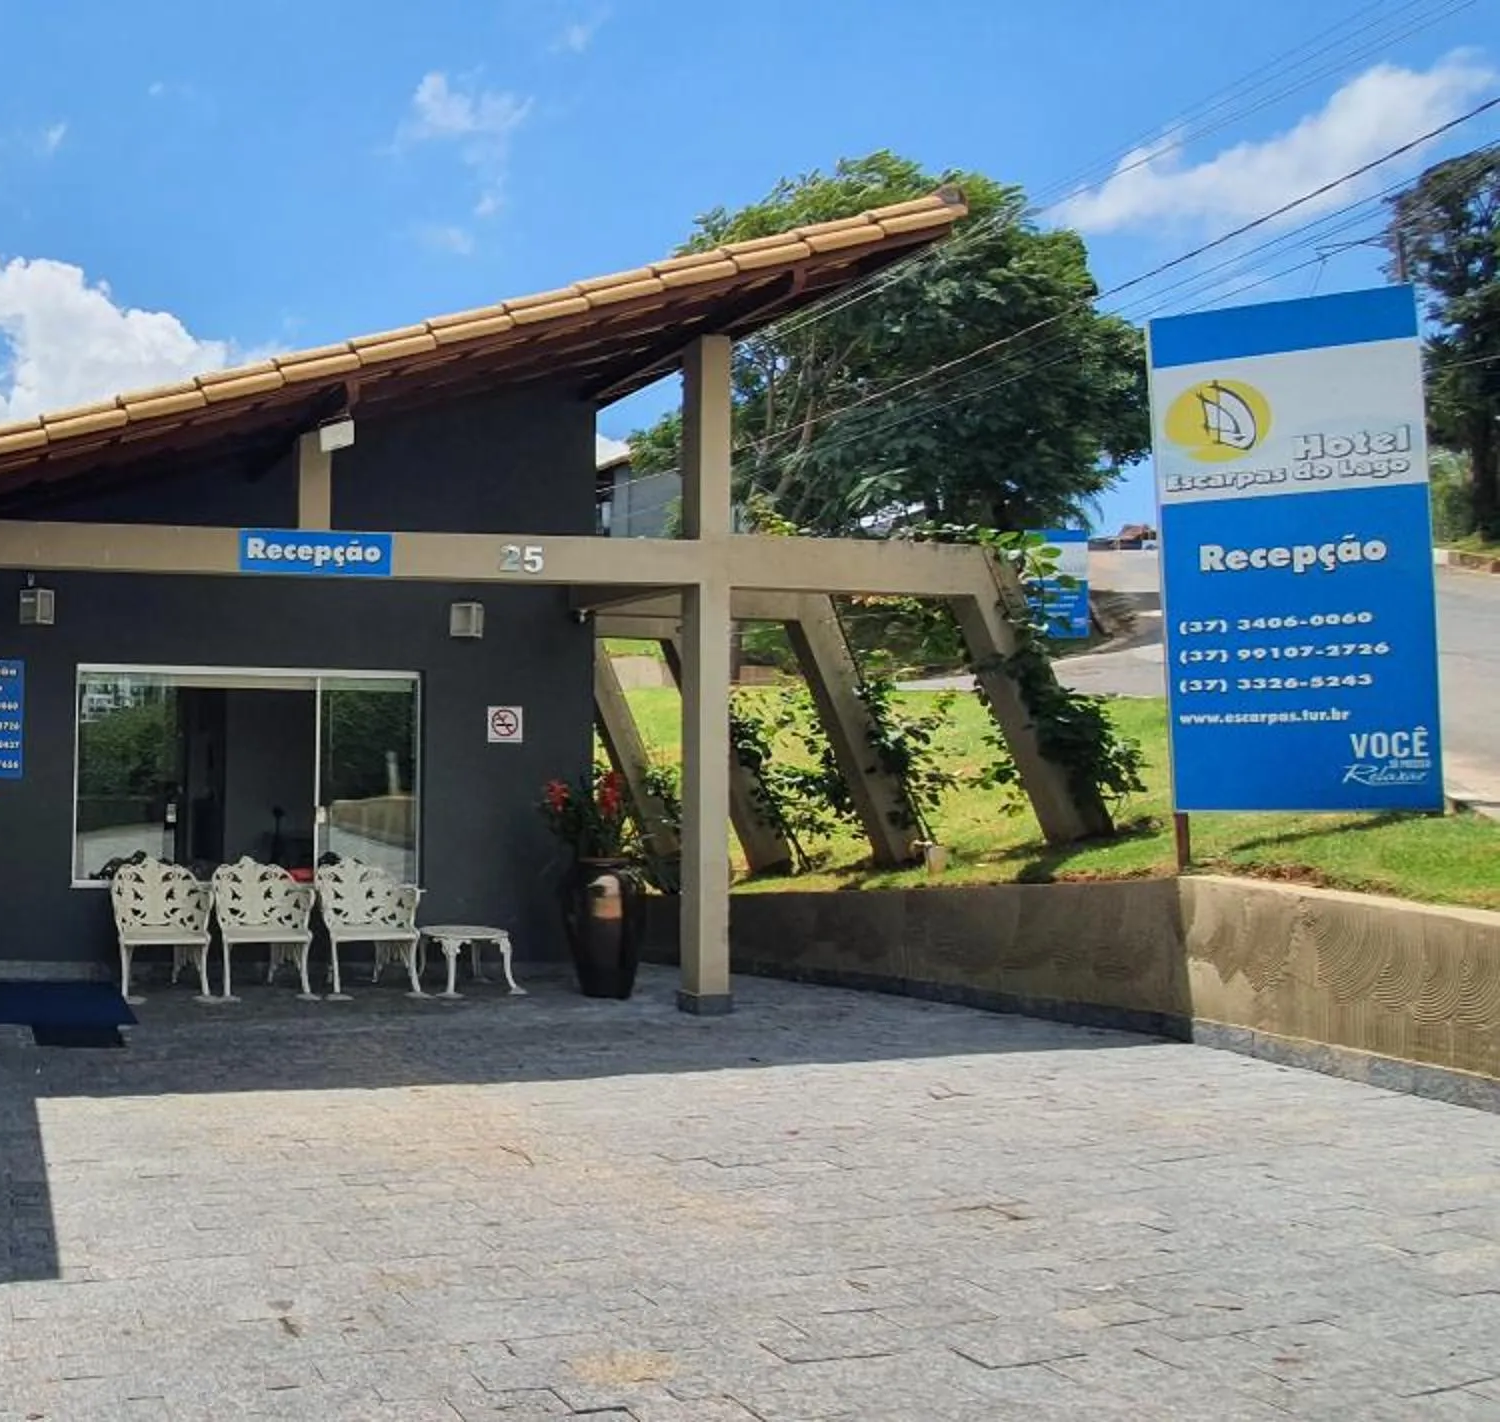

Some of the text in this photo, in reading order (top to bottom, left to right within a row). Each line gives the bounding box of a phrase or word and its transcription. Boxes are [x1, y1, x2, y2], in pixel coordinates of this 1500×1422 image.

[1292, 424, 1411, 462] Hotel
[1165, 457, 1411, 492] Escarpas do Lago
[247, 538, 381, 567] Recepção
[499, 543, 545, 573] 25
[1199, 534, 1388, 573] Recepção
[1179, 611, 1373, 635] (37) 3406-0060
[1179, 641, 1390, 664] (37) 99107-2726
[1179, 673, 1373, 693] (37) 3326-5243
[1179, 707, 1349, 725] www.escarpas.tur.br
[1350, 726, 1430, 759] VOCÊ
